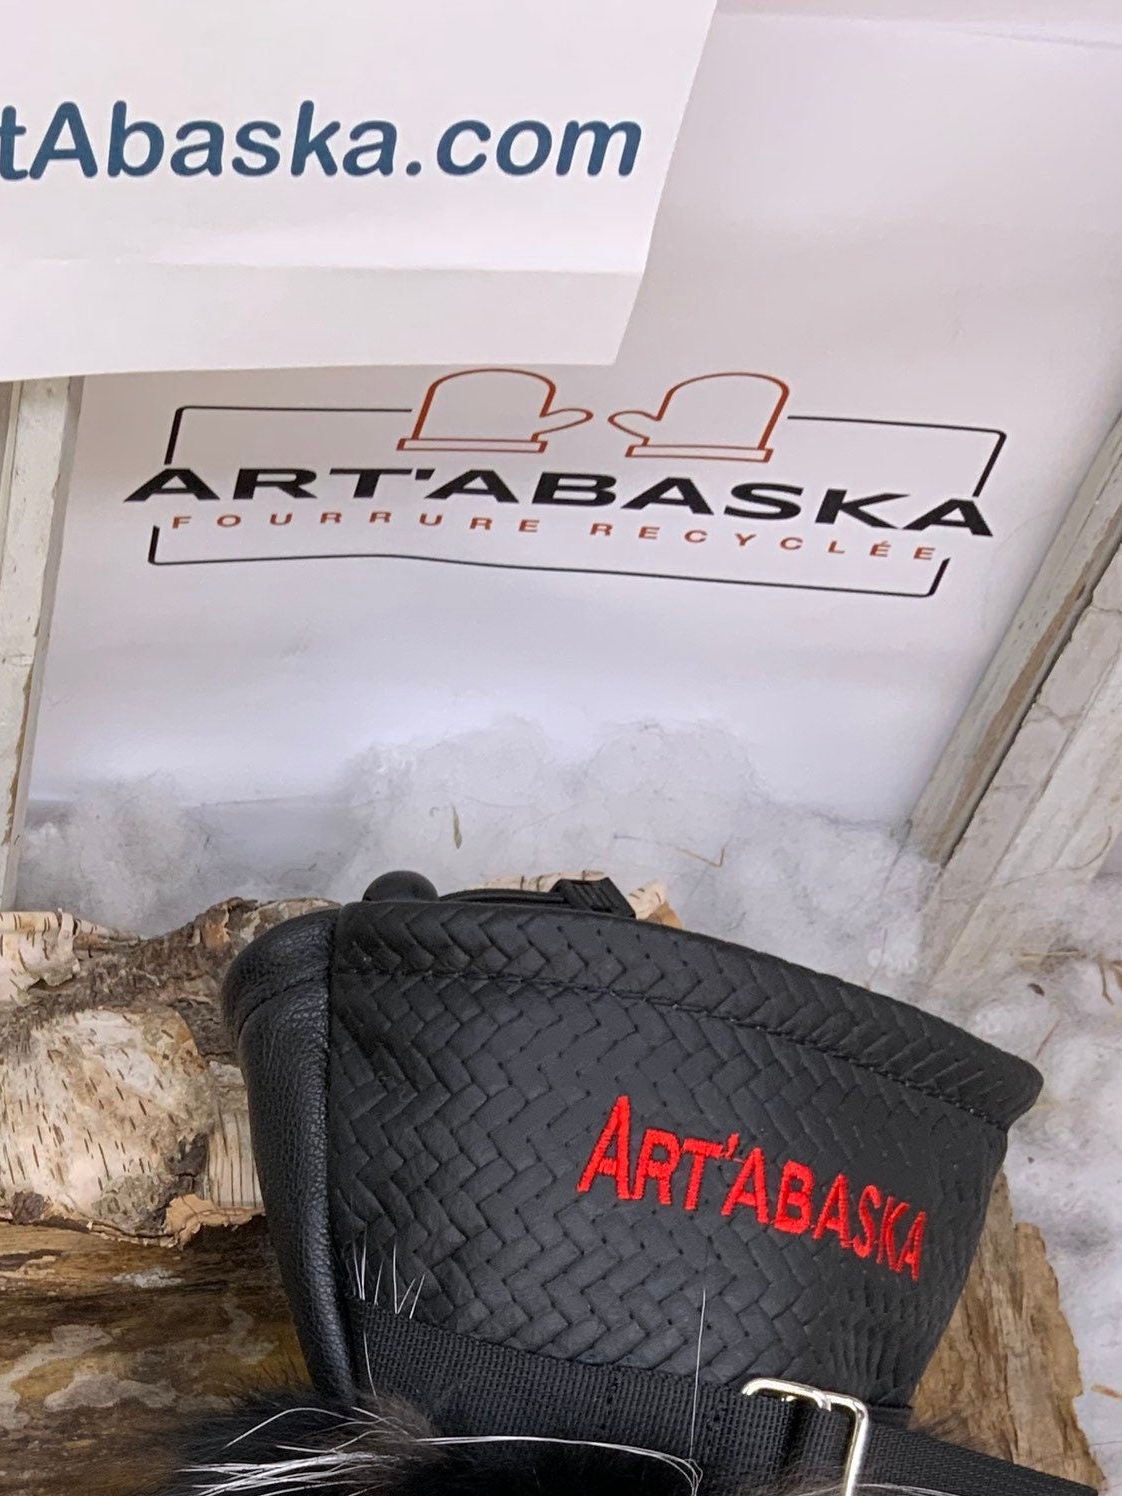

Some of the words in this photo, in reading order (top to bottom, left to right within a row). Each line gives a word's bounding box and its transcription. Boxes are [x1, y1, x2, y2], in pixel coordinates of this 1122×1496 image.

[123, 467, 994, 537] ART'ABASKA
[172, 511, 540, 534] FOURRURE
[590, 522, 938, 561] RECYCLÉE
[578, 1095, 927, 1281] ART'ABASKA
